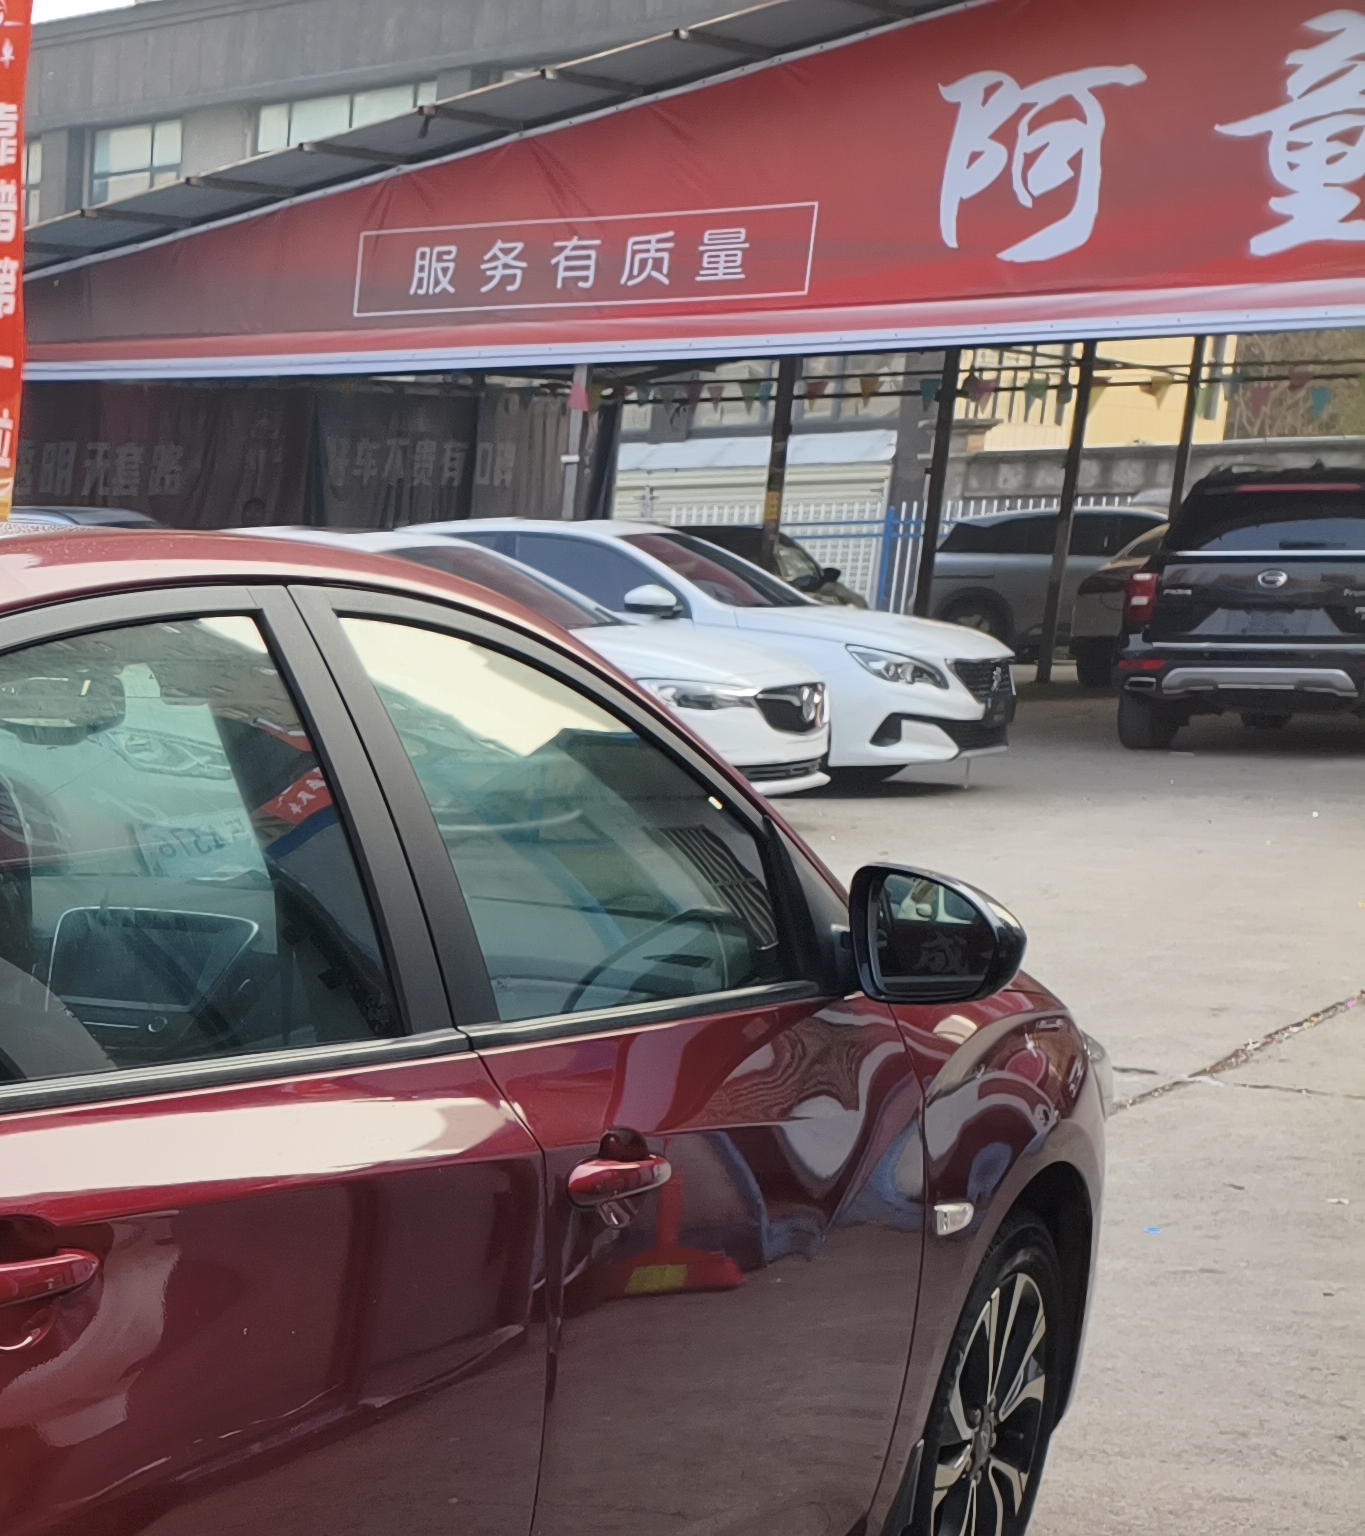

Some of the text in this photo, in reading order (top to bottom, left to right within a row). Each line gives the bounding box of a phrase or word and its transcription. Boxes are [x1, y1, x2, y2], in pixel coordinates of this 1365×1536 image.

[408, 227, 751, 296] 服务有质量
